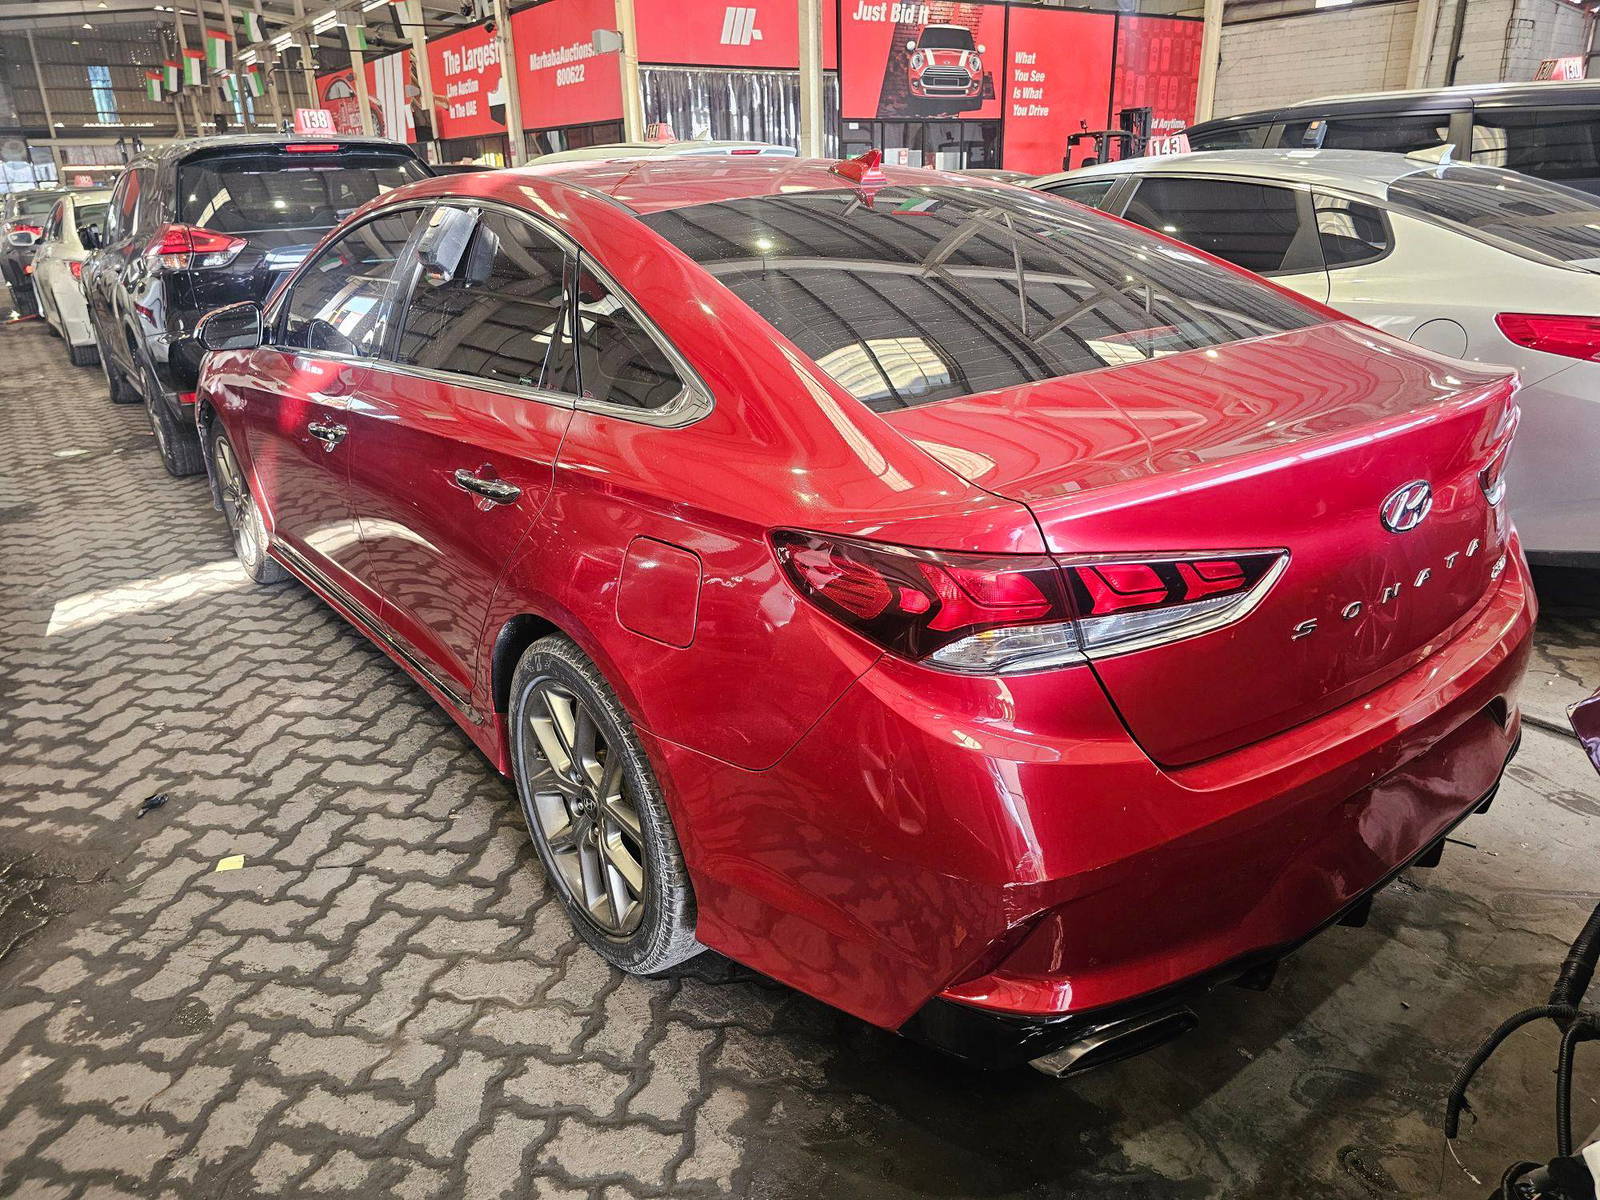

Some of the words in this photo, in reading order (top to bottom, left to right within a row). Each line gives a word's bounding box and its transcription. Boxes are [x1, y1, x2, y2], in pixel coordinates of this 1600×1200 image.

[853, 0, 887, 22] Just
[890, 2, 915, 24] Bid
[917, 5, 930, 25] It
[443, 50, 461, 77] The
[461, 36, 501, 74] Largest
[530, 41, 598, 72] MarhabaAuctions.
[1015, 51, 1036, 65] What
[556, 64, 585, 87] 800622
[1014, 69, 1029, 82] You
[1029, 70, 1046, 83] See
[458, 78, 480, 96] Auction
[1012, 86, 1022, 99] Is
[1022, 87, 1043, 100] What
[449, 104, 456, 119] In
[455, 103, 466, 118] The
[465, 100, 478, 117] UAE
[1013, 103, 1028, 117] You
[1028, 104, 1050, 117] Drive
[302, 110, 330, 129] 138
[1152, 136, 1182, 156] 143
[1291, 537, 1481, 642] SONATA
